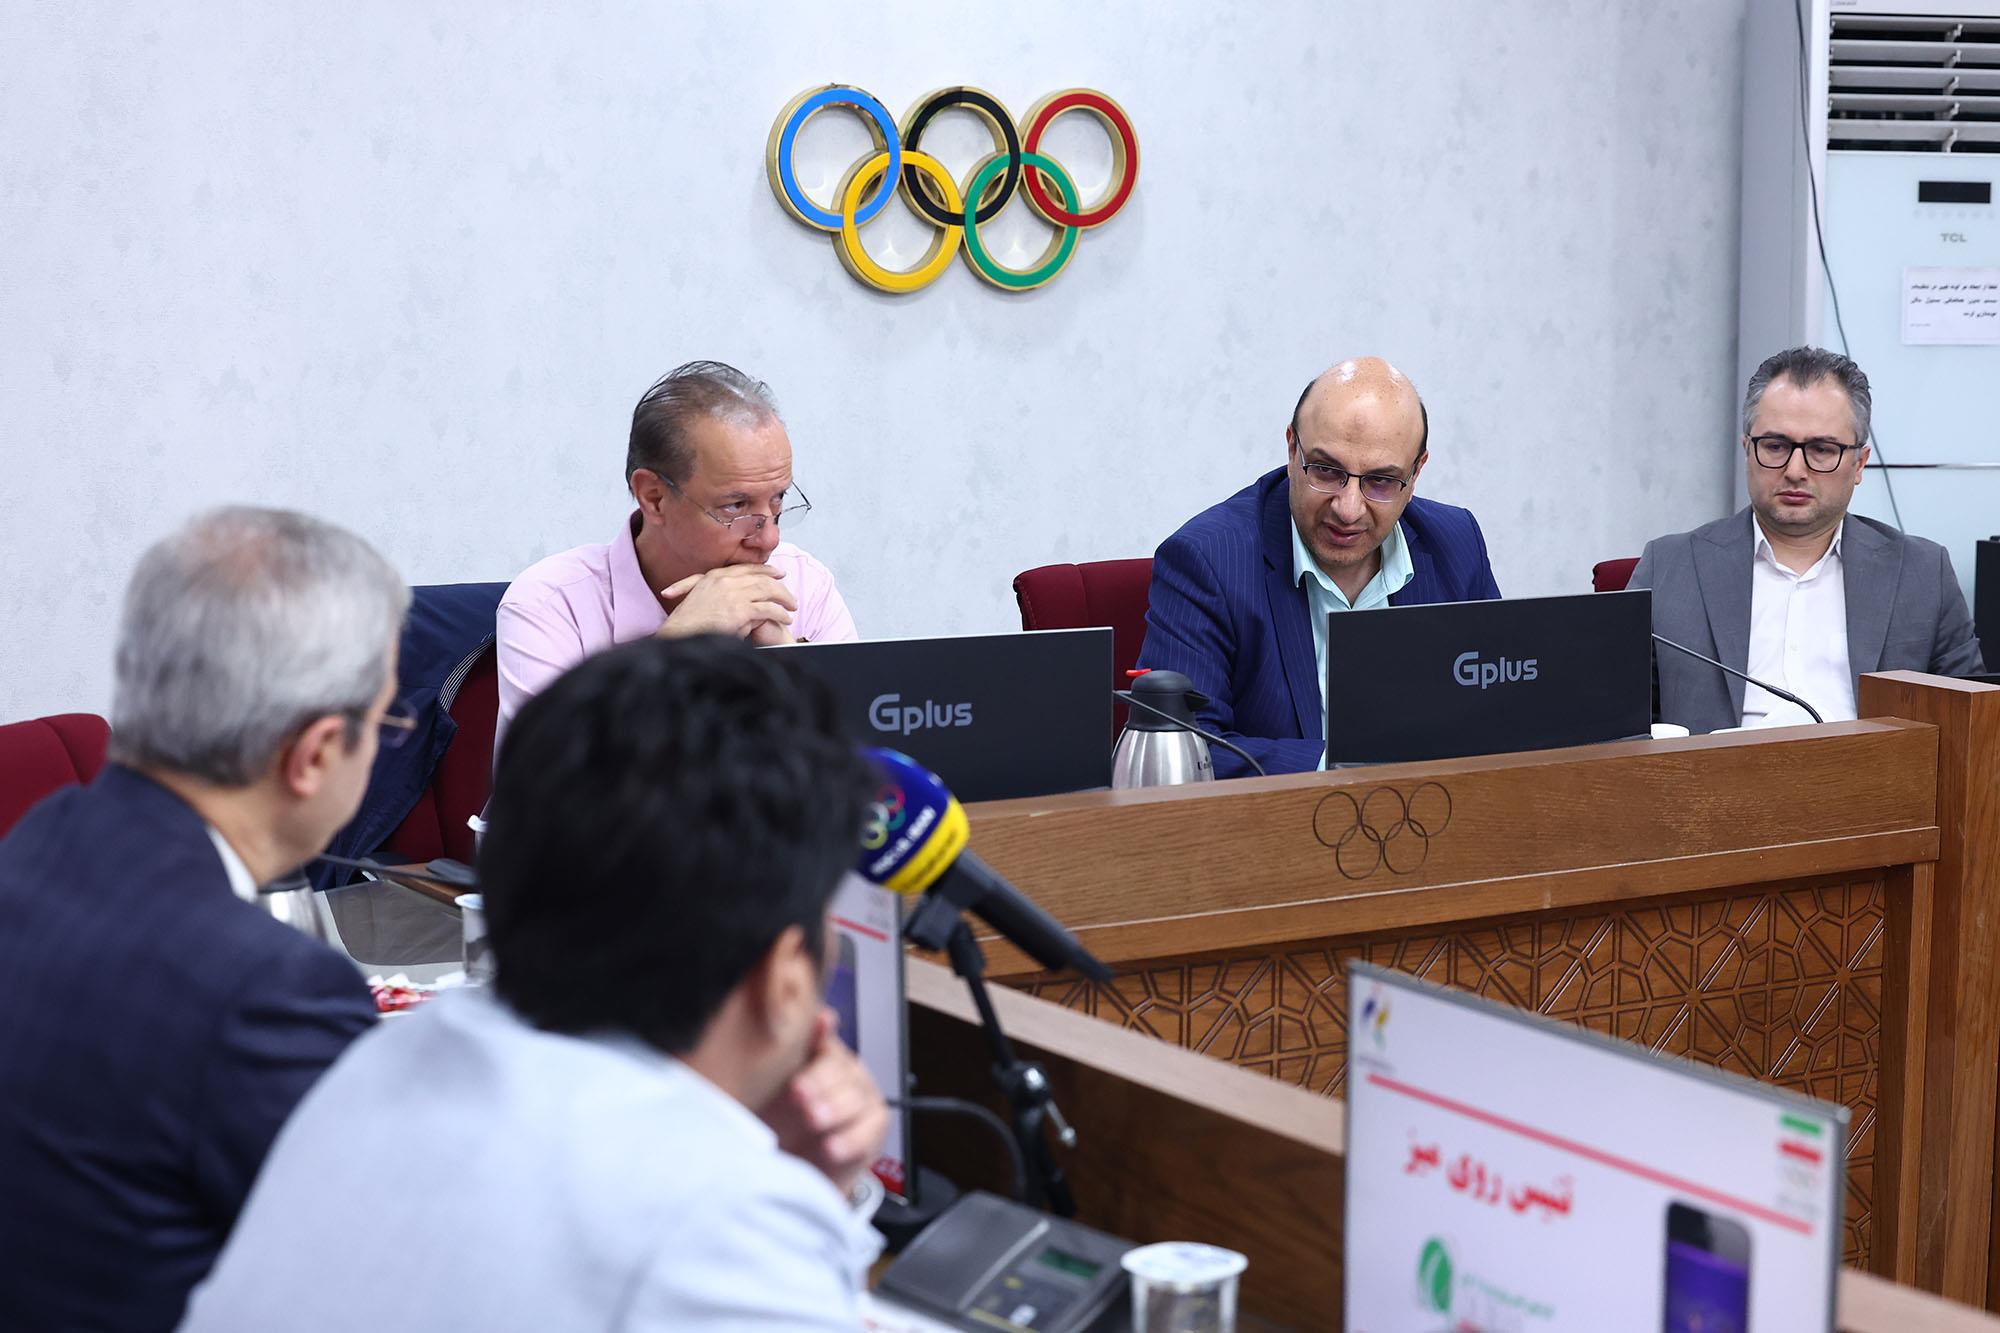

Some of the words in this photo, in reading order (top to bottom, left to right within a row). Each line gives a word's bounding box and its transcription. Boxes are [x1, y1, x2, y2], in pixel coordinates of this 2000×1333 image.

[1940, 231, 1968, 243] TCL
[1453, 651, 1538, 689] Gplus
[869, 693, 973, 736] Gplus
[1446, 1153, 1503, 1206] روی
